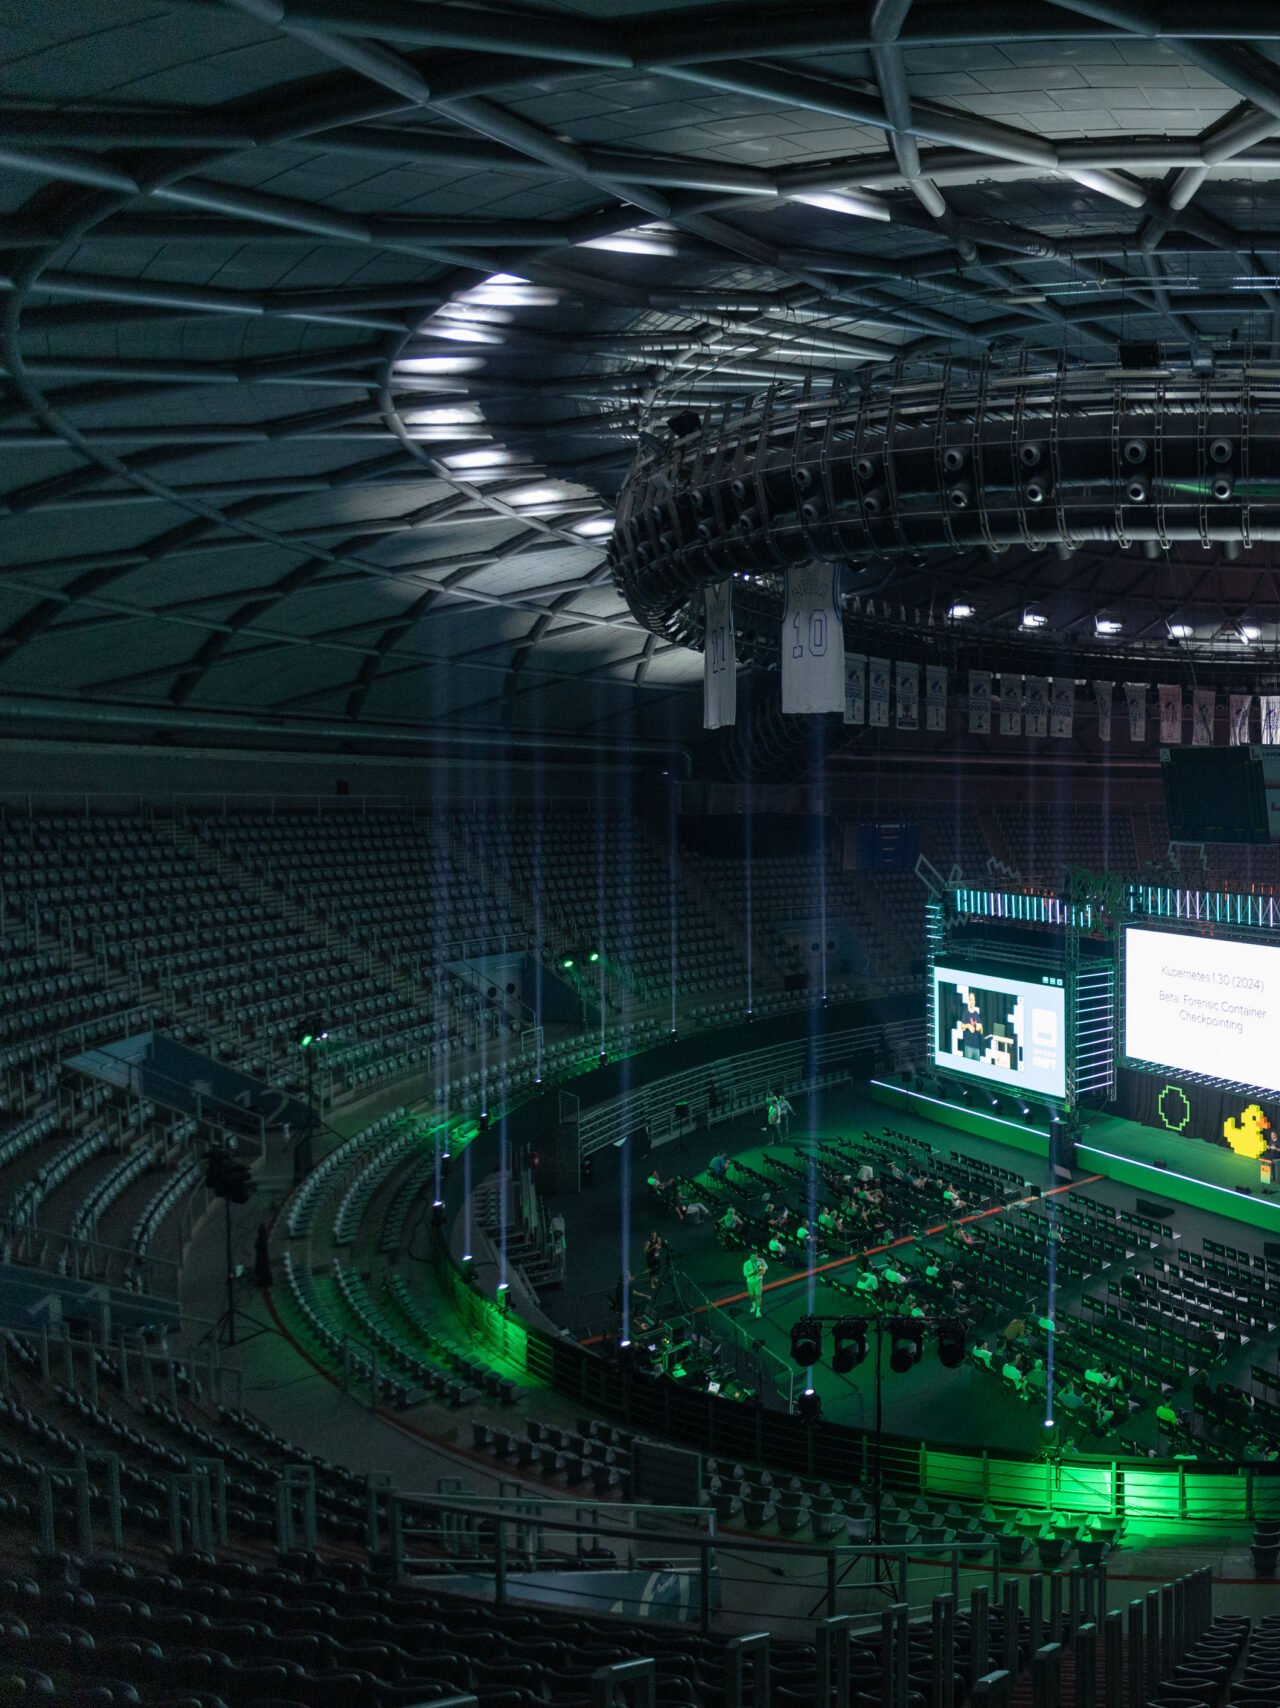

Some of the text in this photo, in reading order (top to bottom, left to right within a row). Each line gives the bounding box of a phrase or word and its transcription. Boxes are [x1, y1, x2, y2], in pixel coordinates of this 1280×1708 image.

[792, 609, 828, 659] 10
[1161, 965, 1265, 993] Kubernetes 1.30 (2024)
[1183, 994, 1219, 1011] Forensic
[1221, 1001, 1267, 1019] Container
[1179, 1009, 1243, 1034] Checkpointing
